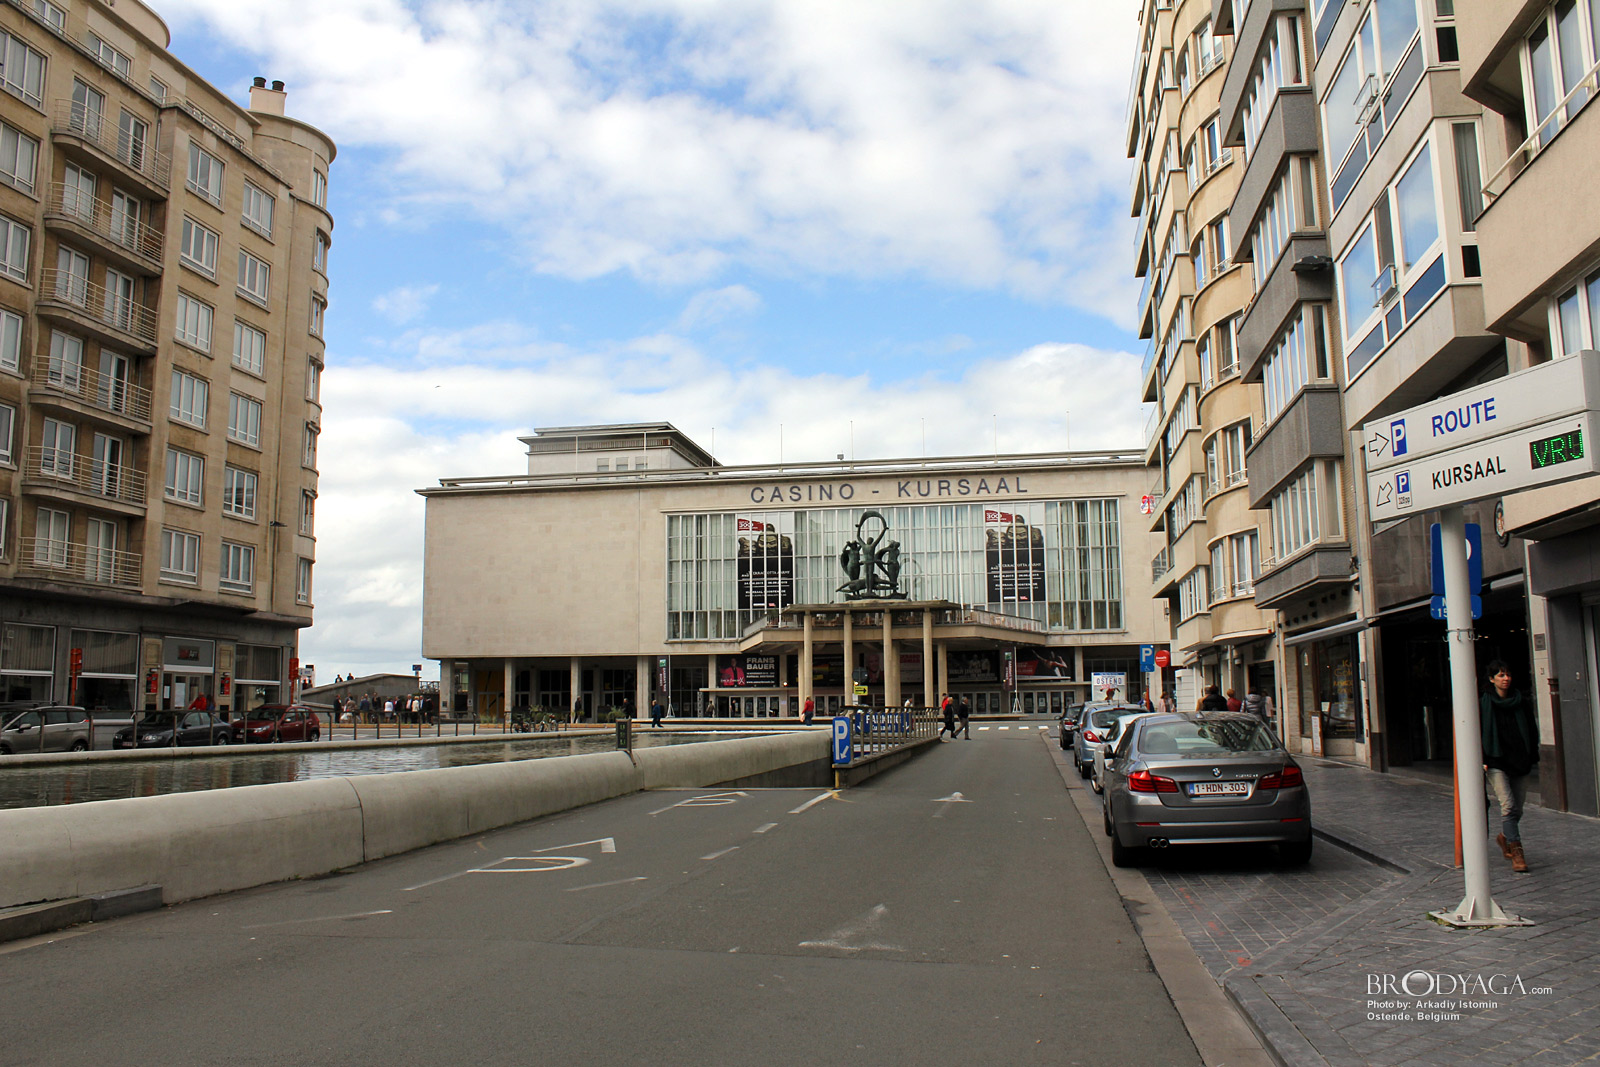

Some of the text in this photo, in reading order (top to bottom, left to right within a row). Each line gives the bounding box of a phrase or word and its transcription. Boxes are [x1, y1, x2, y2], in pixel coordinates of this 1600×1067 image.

[1391, 397, 1497, 452] P ROUTE
[1398, 456, 1506, 492] P KURSAAL
[750, 483, 854, 503] CASINO
[897, 477, 1028, 498] KURSAAL
[1141, 647, 1152, 662] P
[834, 720, 848, 760] P
[1195, 782, 1246, 793] 1-HDN-303
